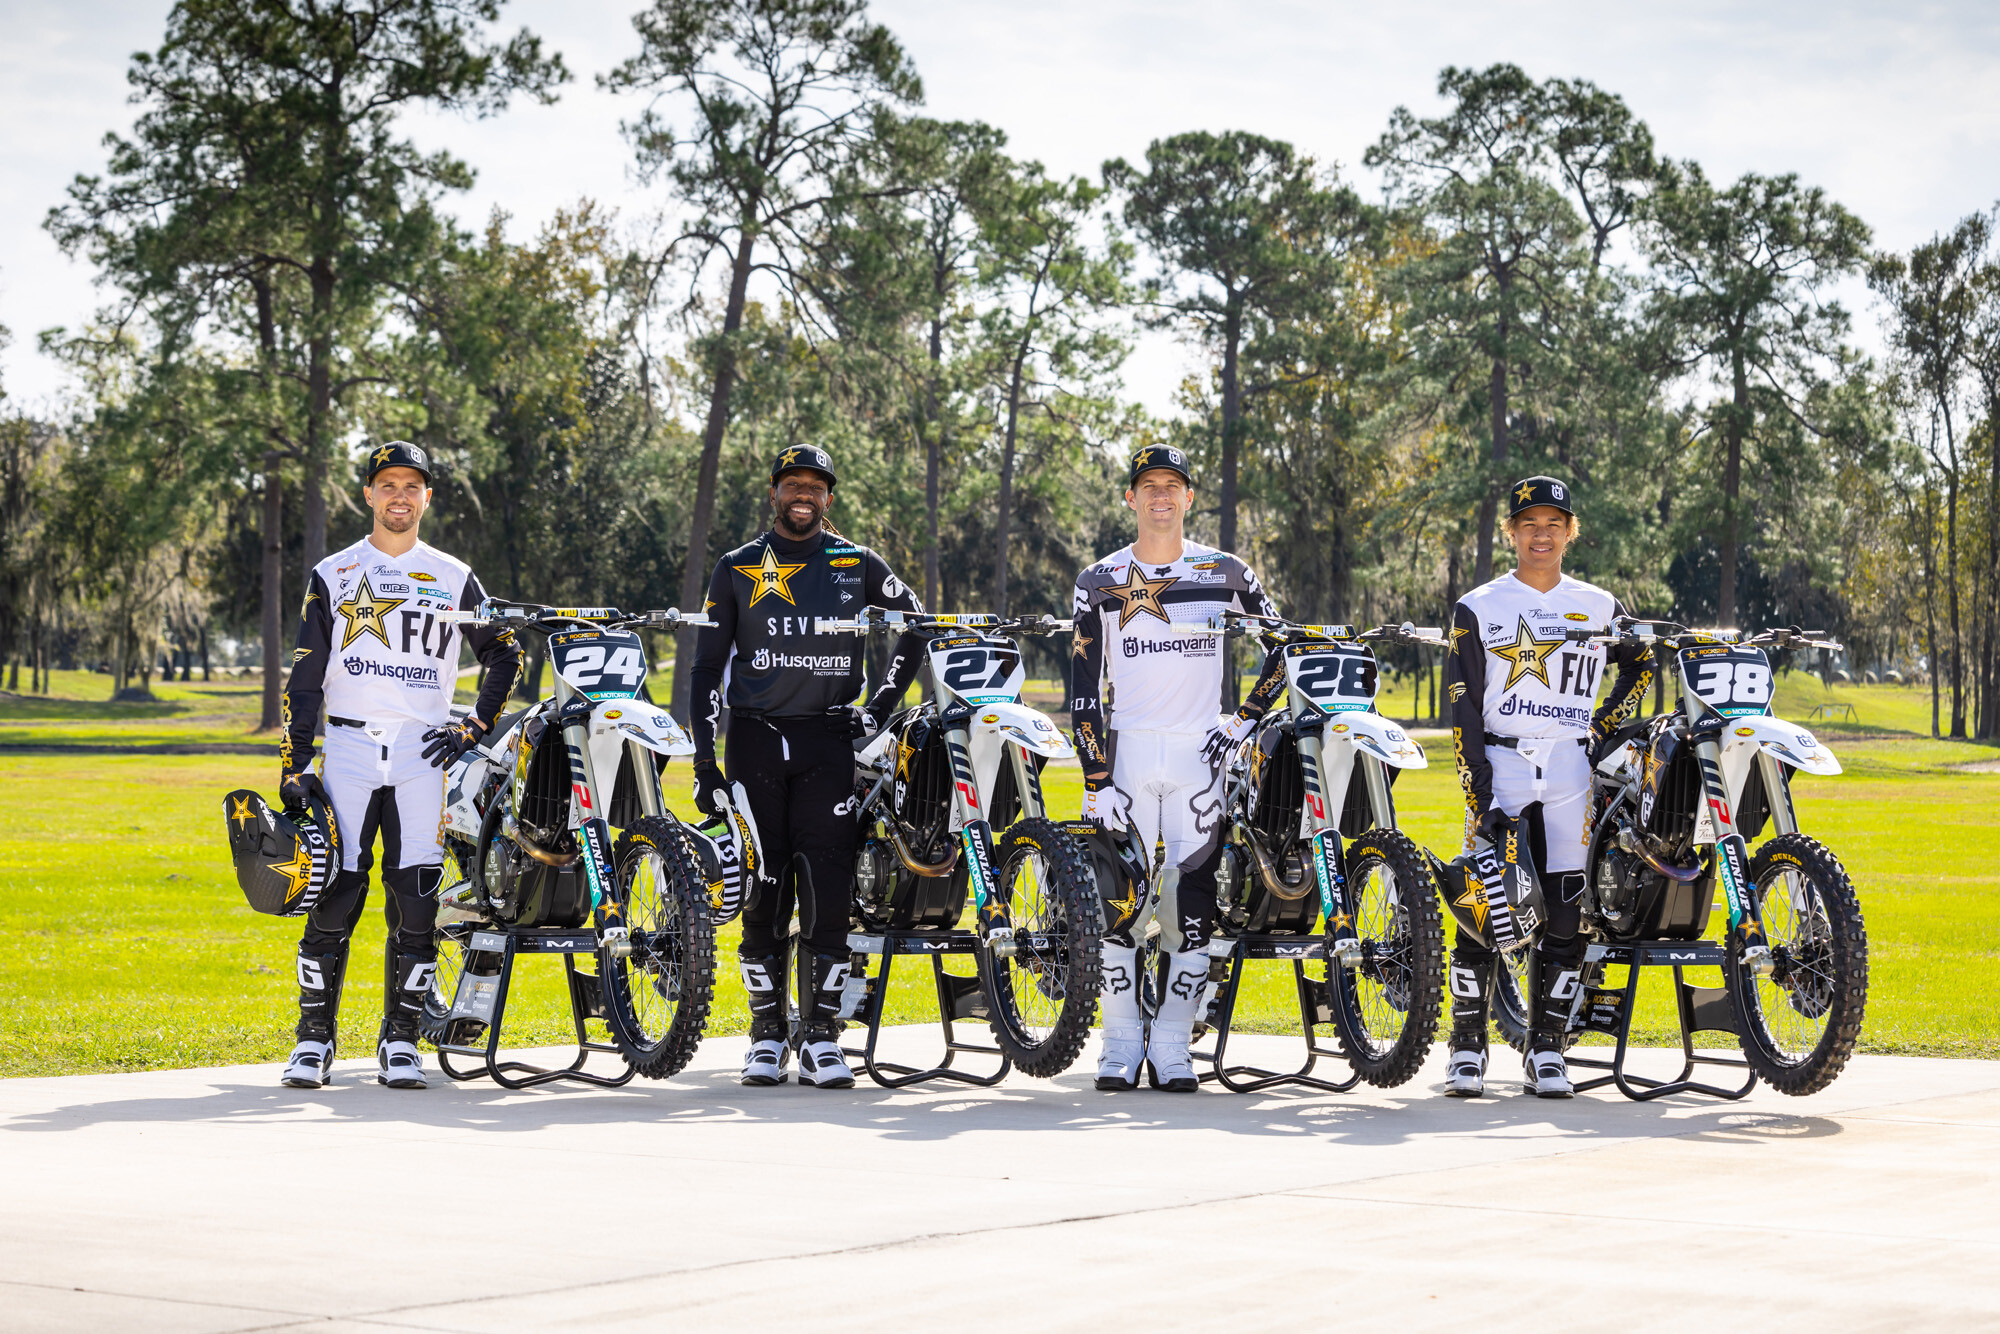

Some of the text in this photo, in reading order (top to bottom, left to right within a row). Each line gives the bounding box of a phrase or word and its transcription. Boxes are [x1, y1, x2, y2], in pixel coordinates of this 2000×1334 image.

[1194, 554, 1225, 562] MOTOREX
[400, 610, 453, 660] FLY
[1141, 637, 1216, 654] Husqvarna
[1488, 636, 1513, 645] SCOTT
[1539, 627, 1567, 635] WPS
[563, 646, 644, 687] 24
[772, 653, 851, 670] Husqvarna
[943, 650, 1020, 691] 27
[1296, 657, 1378, 698] 28
[1559, 652, 1598, 698] FLY
[1697, 662, 1770, 705] 38
[1226, 709, 1249, 736] FOX
[1087, 782, 1097, 814] FOX
[734, 812, 755, 870] ROCKSTAR
[582, 845, 600, 896] MOTOREX
[966, 848, 985, 897] MOTOREX
[1316, 856, 1331, 907] MOTOREX
[1720, 863, 1741, 915] MOTOREX
[1725, 843, 1751, 911] DUNLOP
[1593, 995, 1621, 1006] ROCKSTAR
